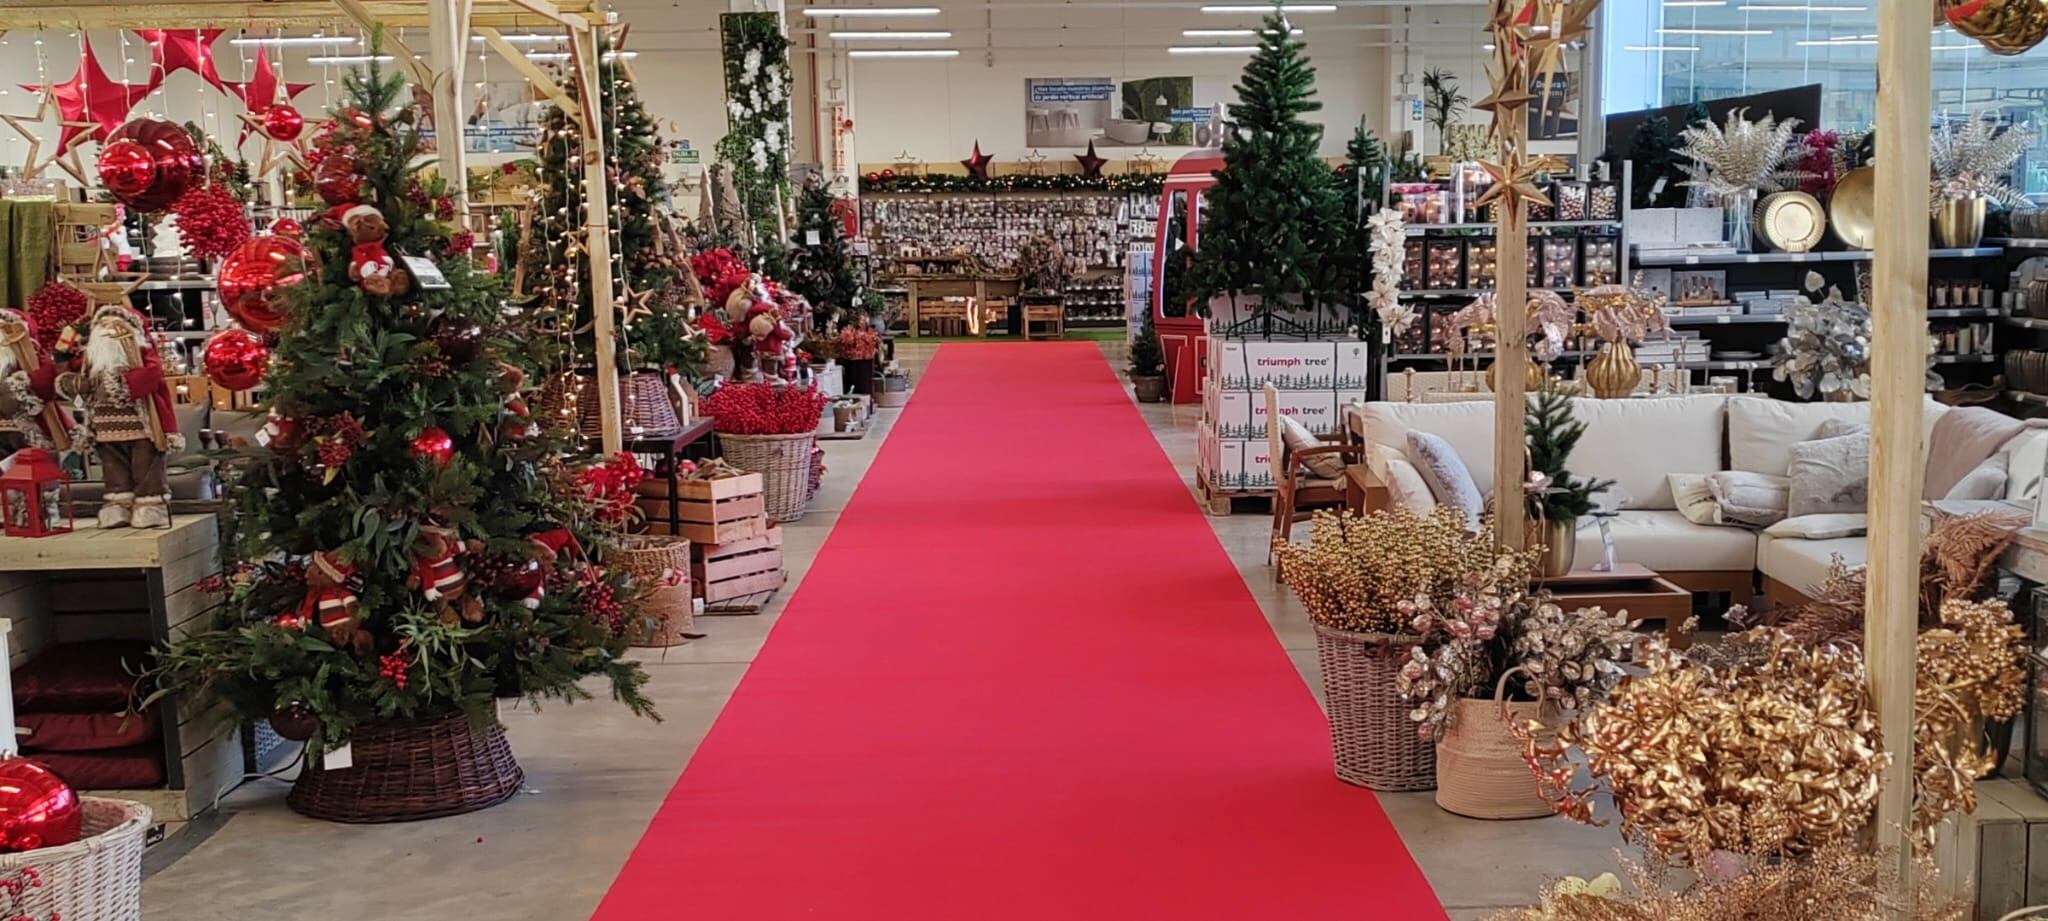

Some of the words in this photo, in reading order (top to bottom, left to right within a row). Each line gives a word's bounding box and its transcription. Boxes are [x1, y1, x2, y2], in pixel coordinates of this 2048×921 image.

[1257, 356, 1301, 368] triumph
[1305, 357, 1328, 366] tree
[1302, 407, 1325, 415] tree
